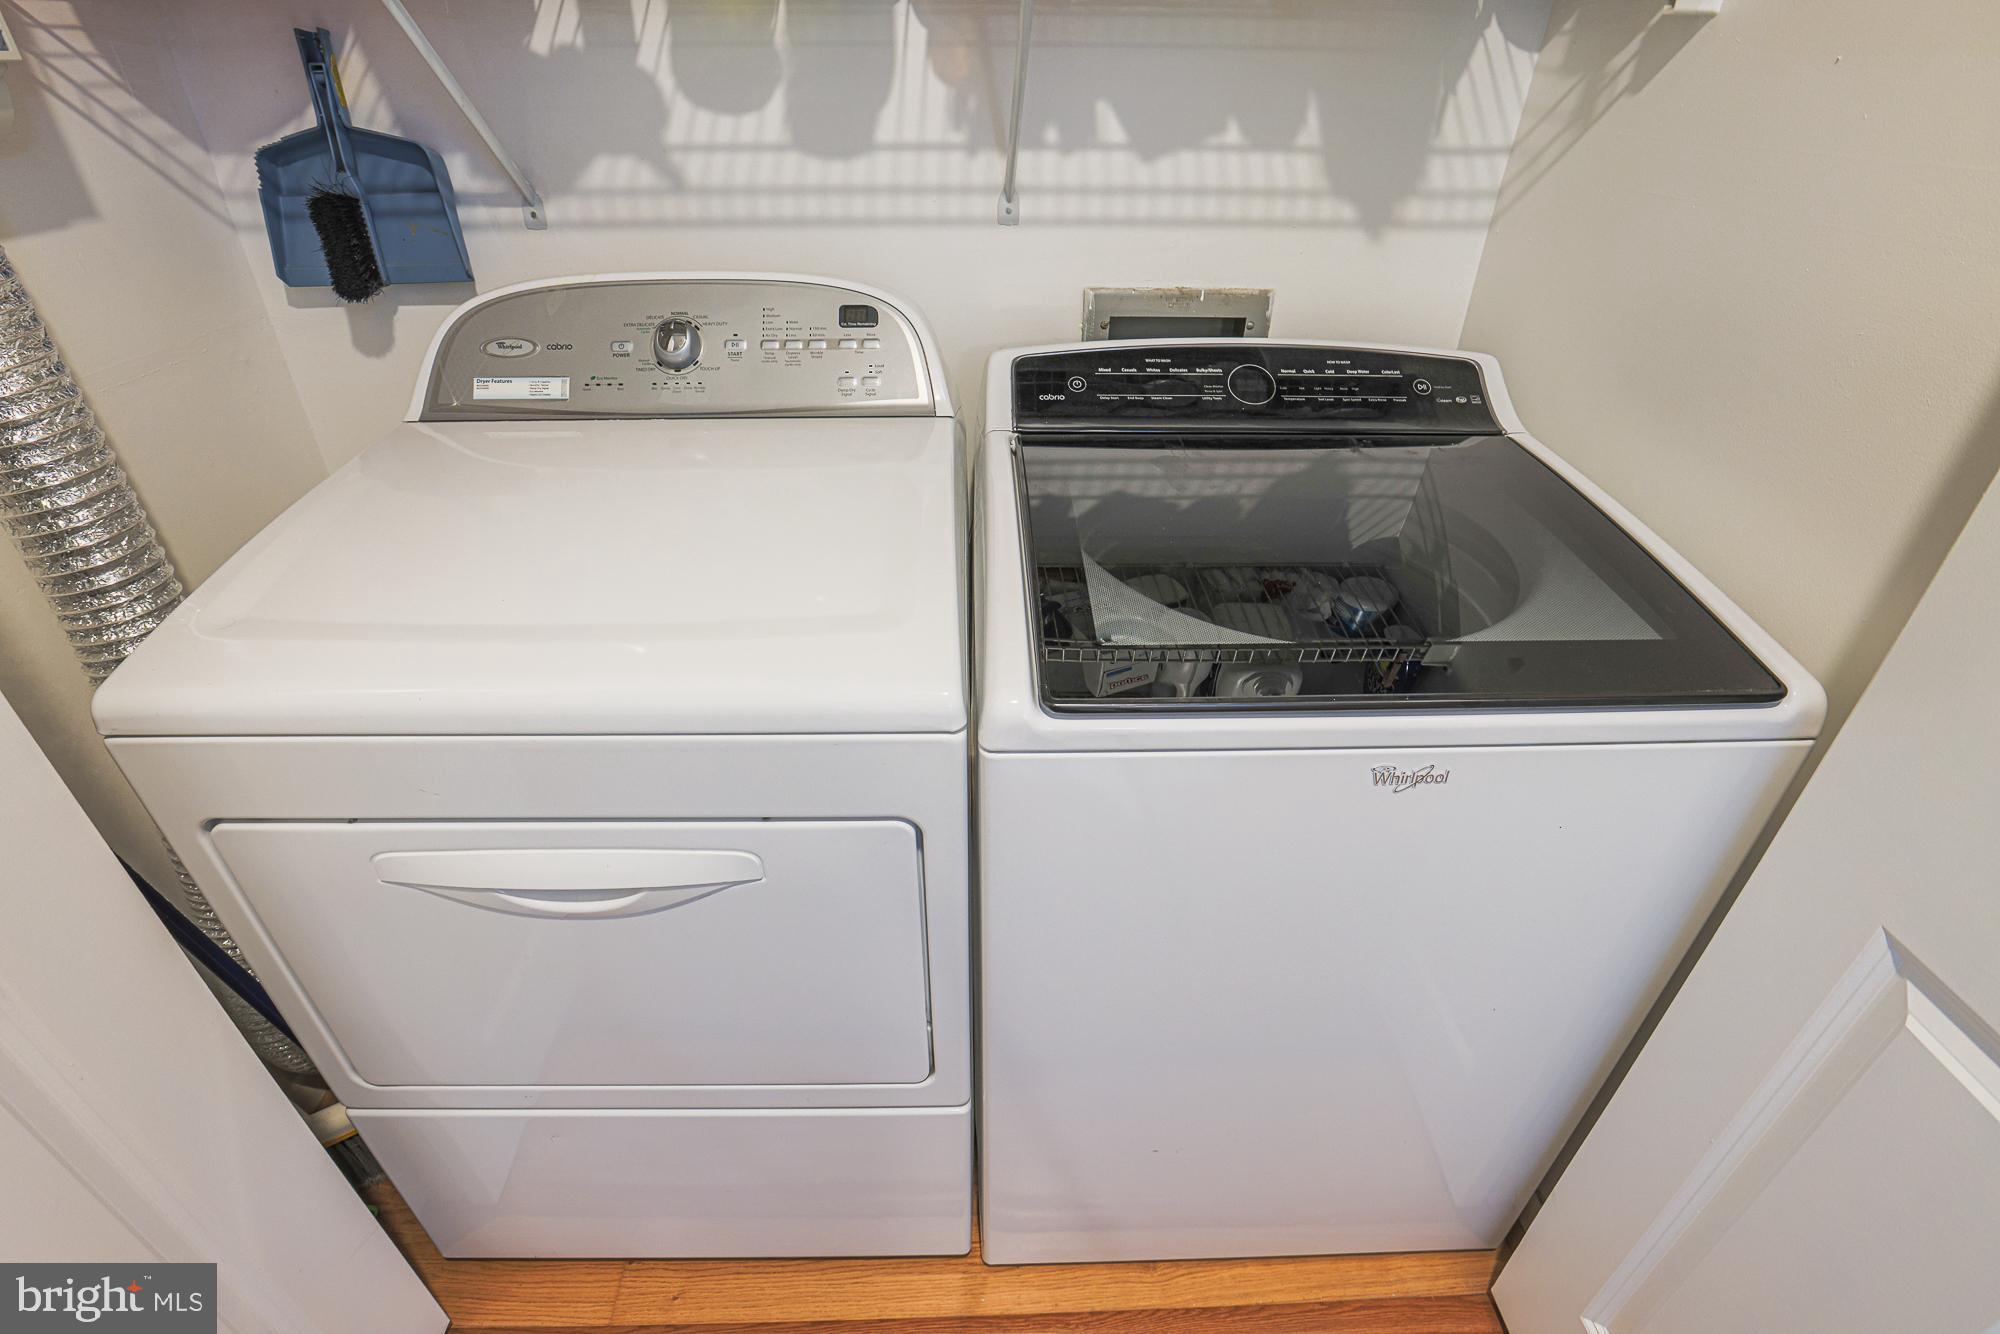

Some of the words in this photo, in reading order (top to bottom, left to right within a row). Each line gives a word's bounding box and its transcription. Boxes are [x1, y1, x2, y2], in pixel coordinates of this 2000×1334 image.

[496, 341, 523, 352] Whirlpool
[546, 342, 573, 351] cabrio
[1371, 765, 1450, 793] Whirlpool
